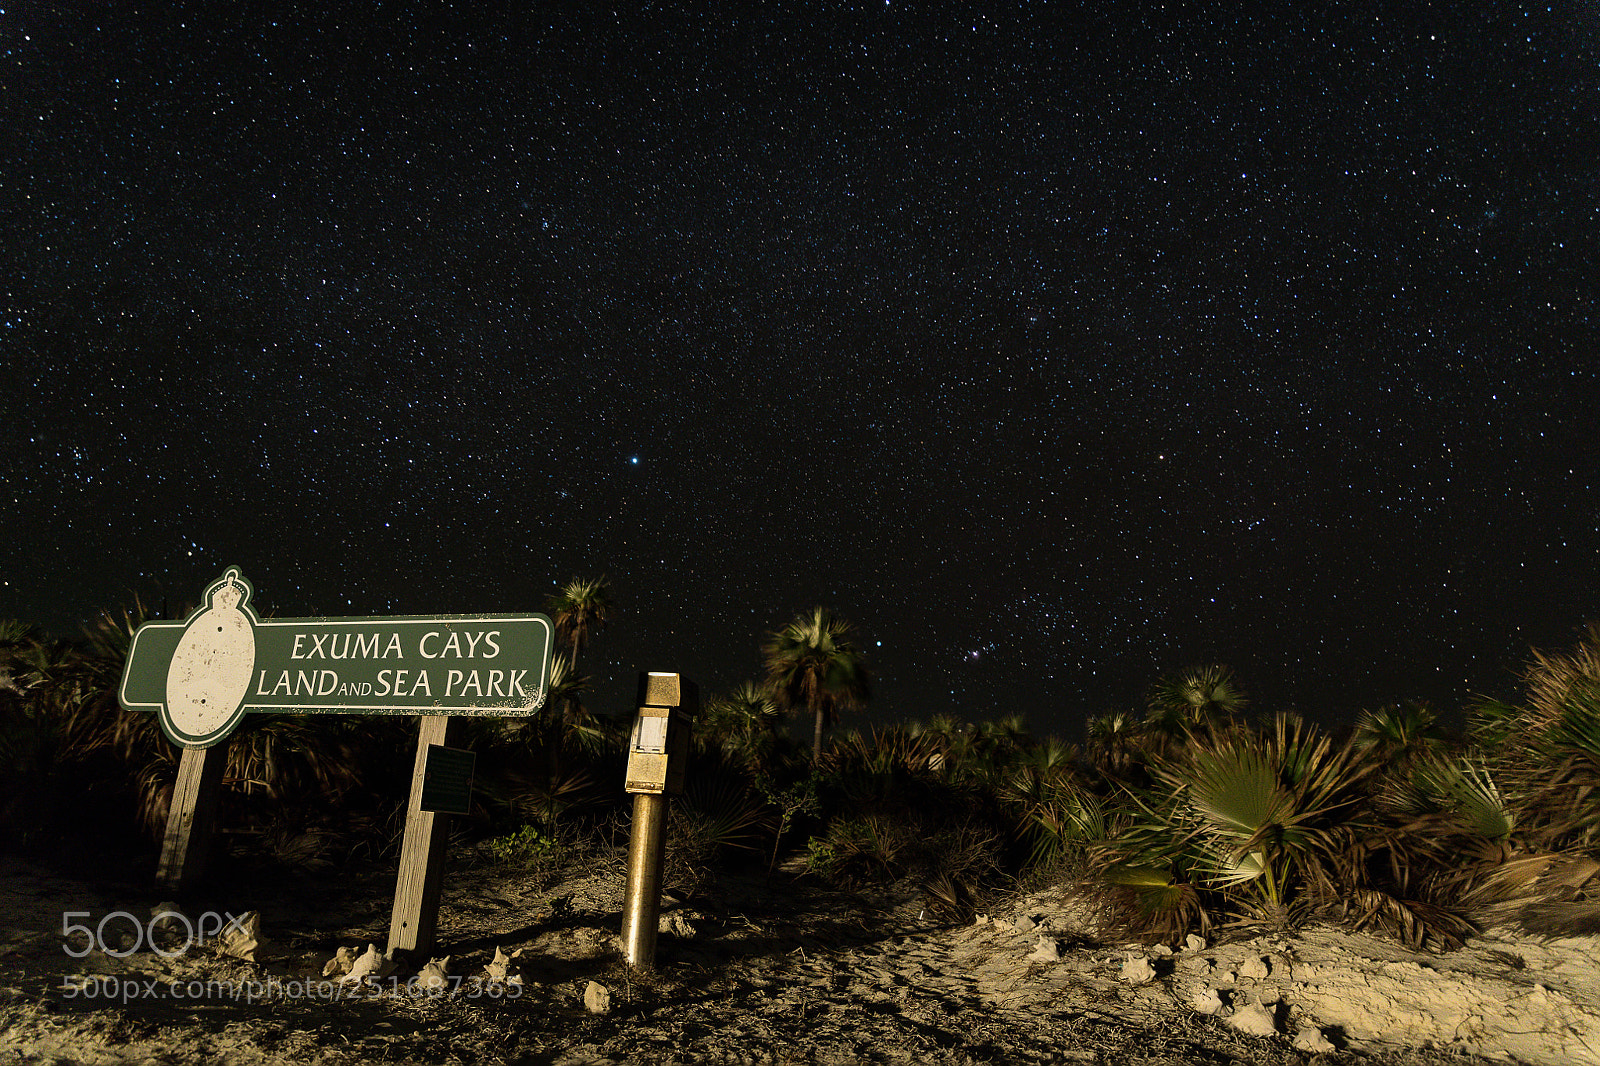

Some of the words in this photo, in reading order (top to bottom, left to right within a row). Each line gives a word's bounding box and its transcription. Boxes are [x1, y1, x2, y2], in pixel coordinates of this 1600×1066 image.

[290, 632, 403, 660] EXUMA
[419, 630, 501, 659] CAYS
[256, 669, 338, 697] LAND
[337, 682, 372, 697] AND
[374, 669, 432, 697] SEA
[444, 669, 528, 698] PARK
